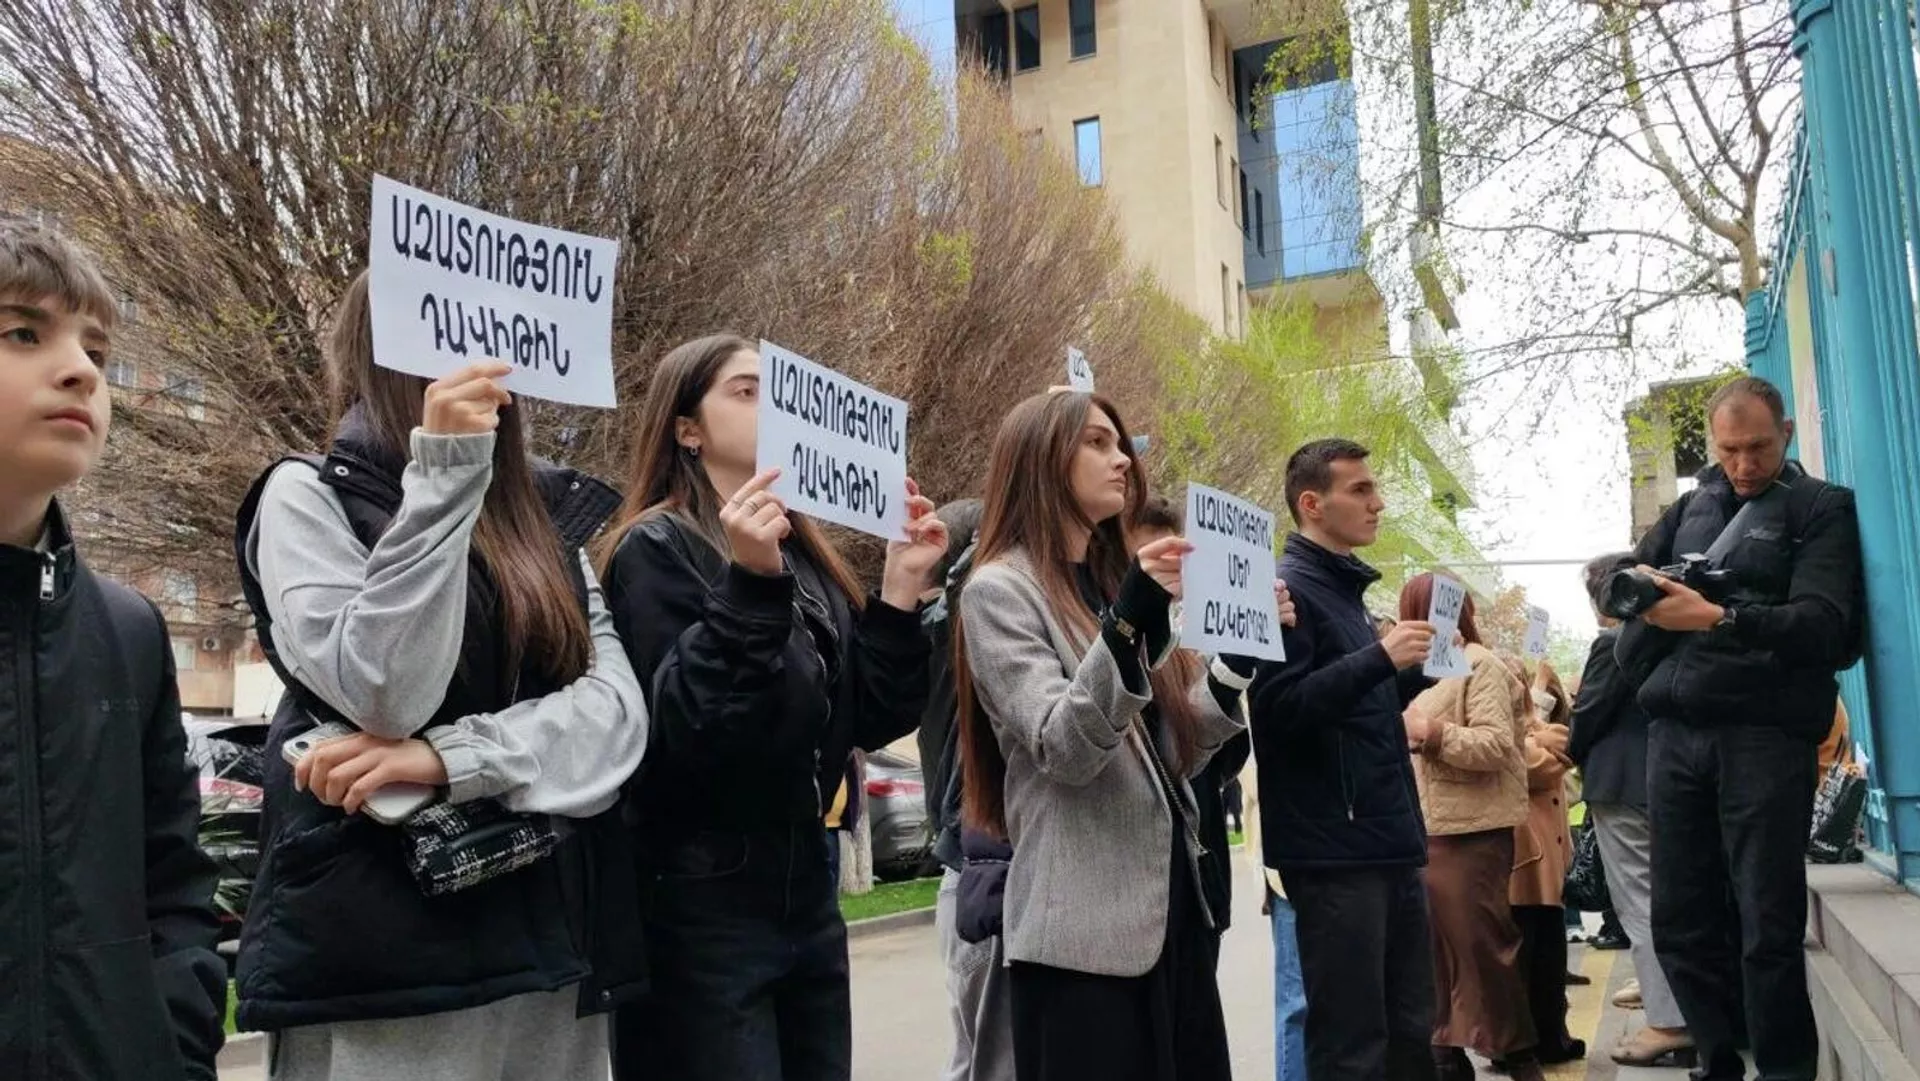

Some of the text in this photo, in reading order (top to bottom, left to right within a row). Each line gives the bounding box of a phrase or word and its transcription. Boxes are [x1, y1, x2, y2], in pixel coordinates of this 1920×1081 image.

[393, 194, 602, 303] ԱԶԱՏՈՒԹՅՈՒՆ
[421, 293, 570, 377] ԴԱՎԻԹԻՆ
[772, 356, 899, 455] ԱԶԱՏՈՒԹՅՈՒՆ
[793, 442, 886, 520] ԴԱՎԻԹԻՆ
[1228, 552, 1250, 589] ՄԵՐ
